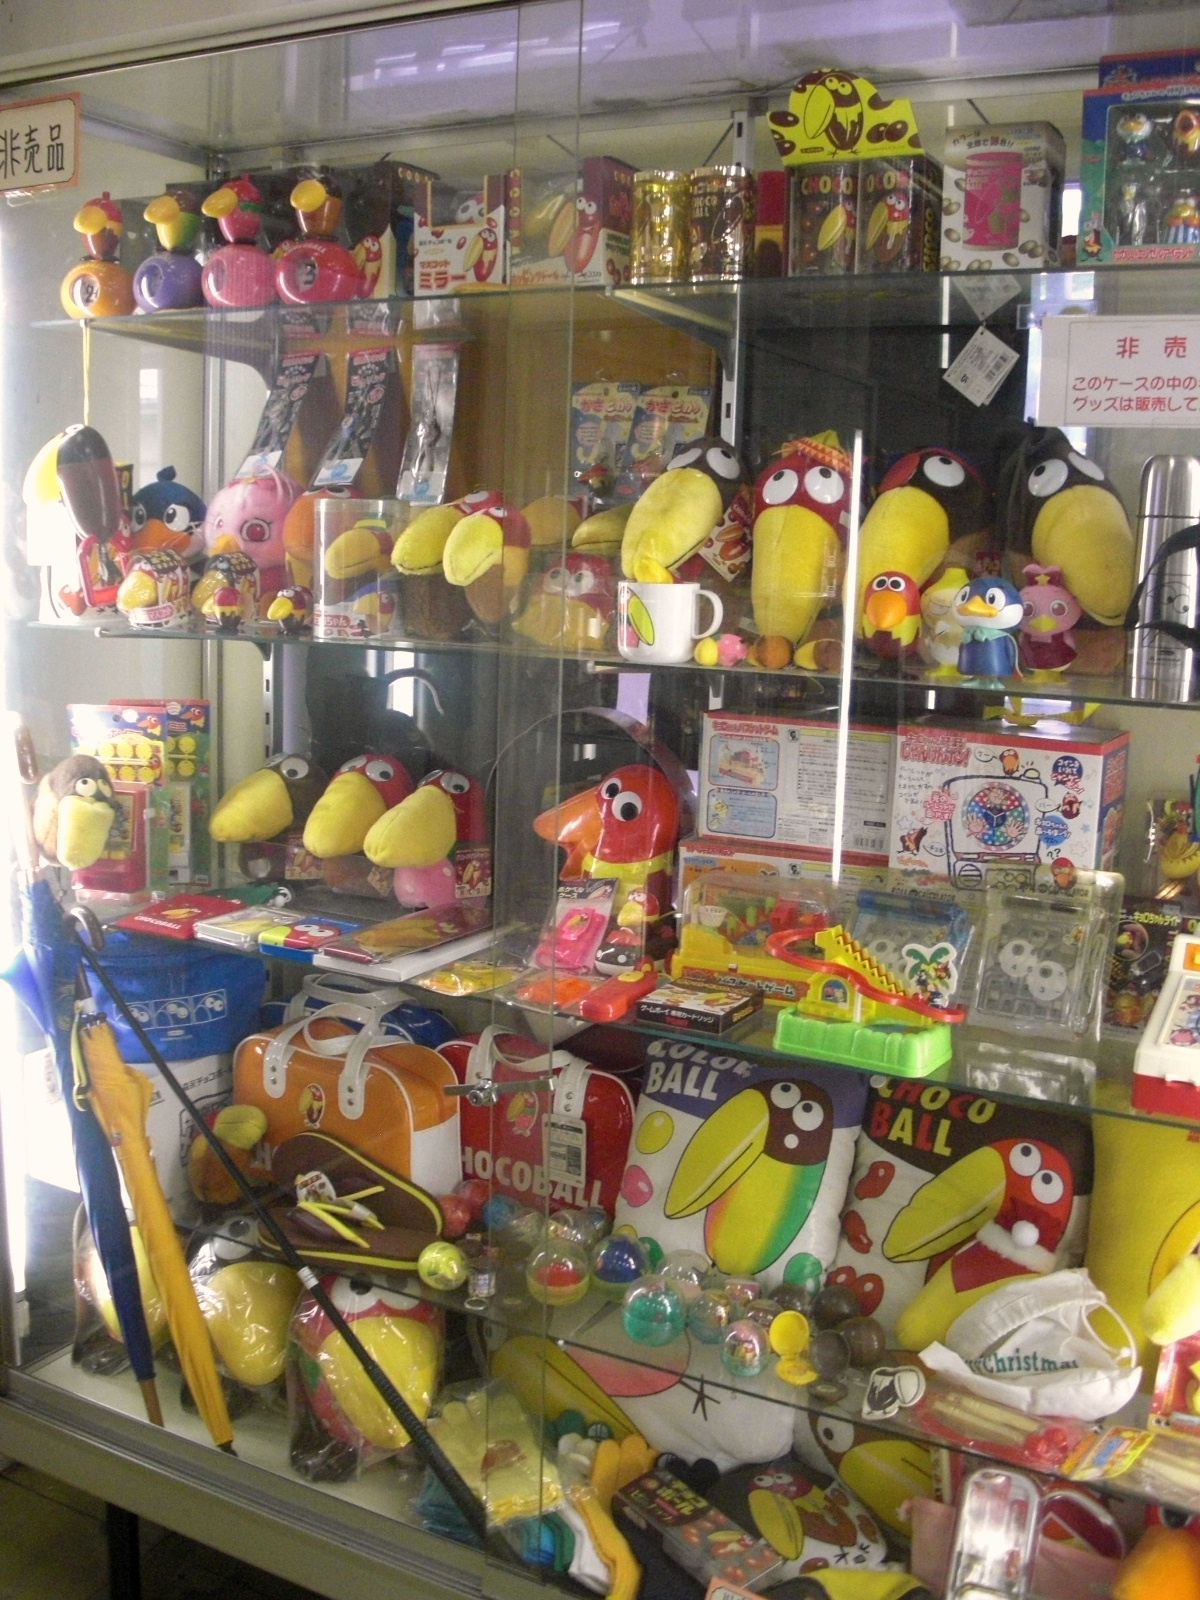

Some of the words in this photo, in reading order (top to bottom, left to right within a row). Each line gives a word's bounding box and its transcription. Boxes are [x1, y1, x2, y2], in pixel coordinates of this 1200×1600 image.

[0, 123, 65, 179] 非売品
[419, 270, 467, 290] ミラー
[1116, 336, 1139, 359] 非
[1164, 335, 1187, 358] 売
[1072, 375, 1200, 391] このケースの中の
[1072, 395, 1199, 412] グッズは販売して
[1132, 911, 1181, 928] キョロちゃんライト
[640, 1004, 670, 1016] ゲームボーイ
[670, 1009, 714, 1023] 専用カートリッジ
[646, 1038, 758, 1079] COLOR
[645, 1061, 720, 1101] BALL
[874, 1076, 997, 1124] CHOCO
[869, 1101, 952, 1157] BALL
